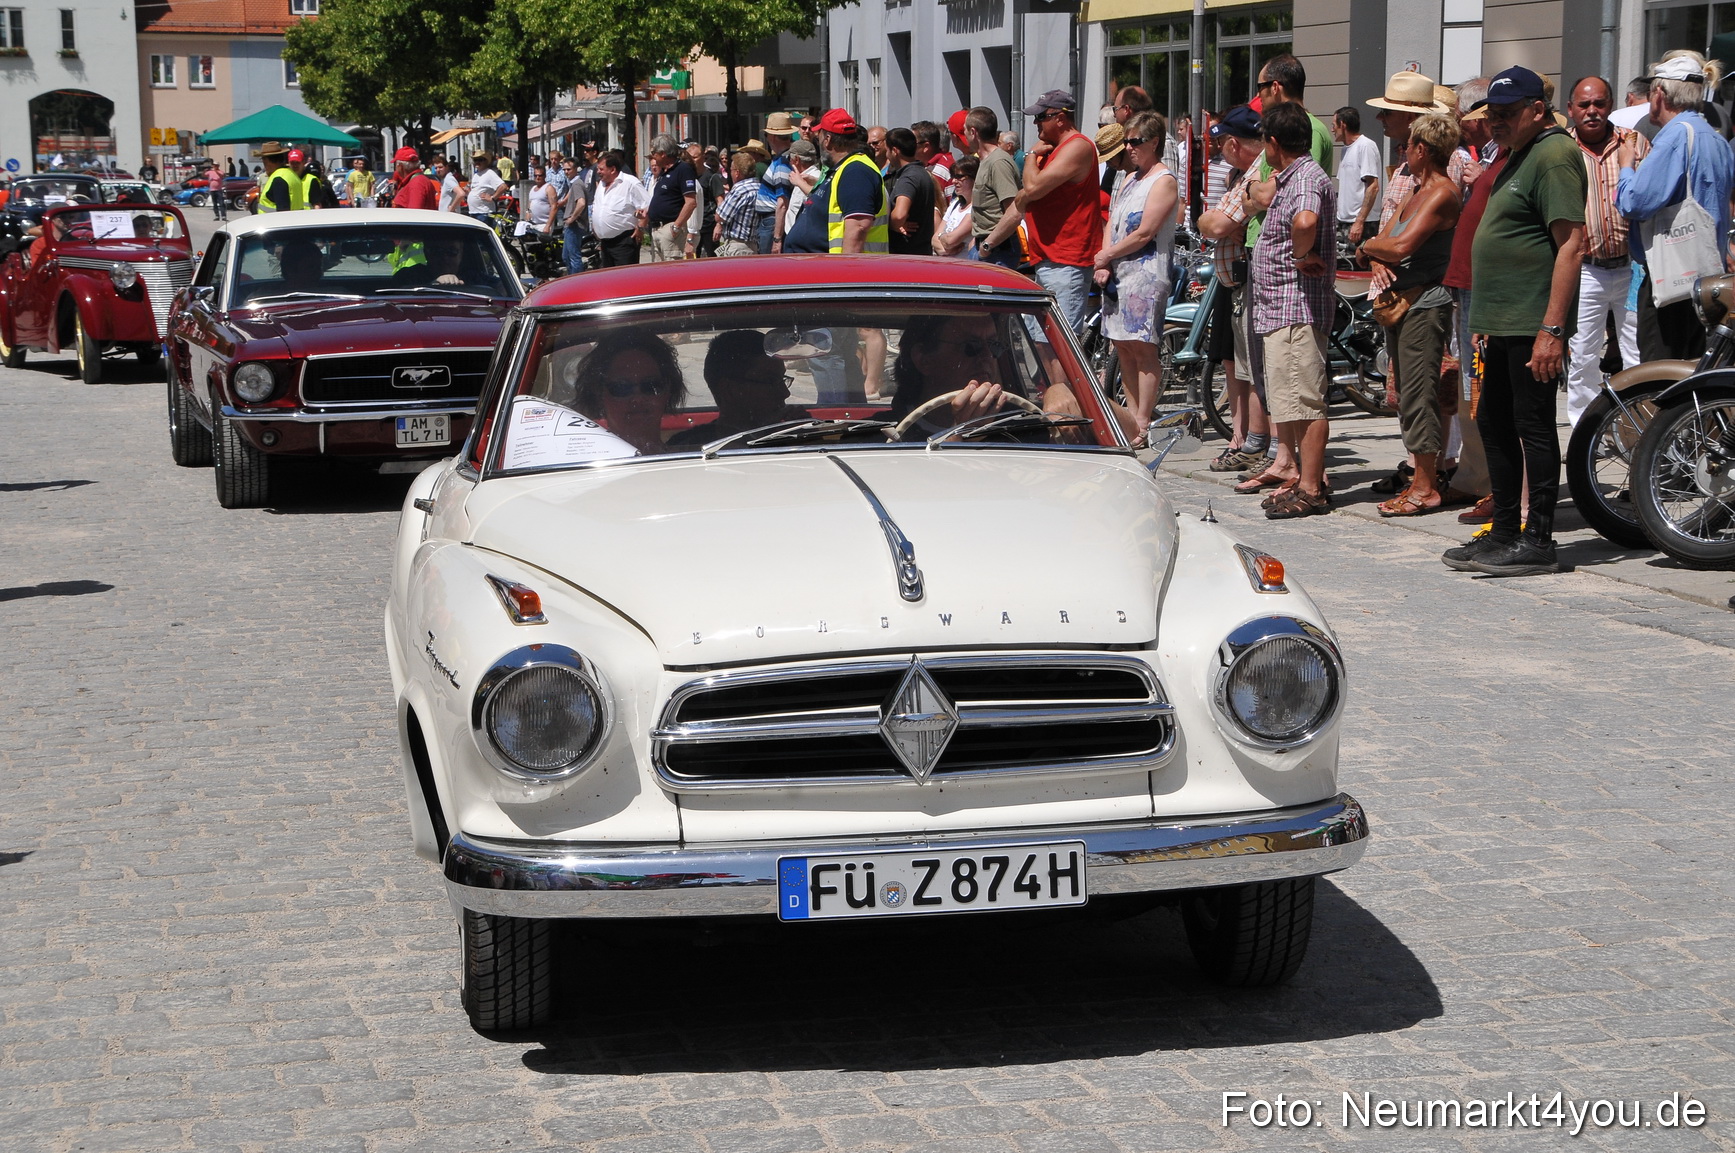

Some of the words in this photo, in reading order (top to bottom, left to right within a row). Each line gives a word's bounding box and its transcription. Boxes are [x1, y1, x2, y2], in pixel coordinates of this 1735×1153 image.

[411, 418, 428, 429] AM
[402, 430, 419, 442] TL
[423, 430, 431, 441] 7
[435, 429, 444, 440] H
[691, 609, 1128, 645] BORGWARD
[810, 861, 876, 911] FÜ
[788, 894, 800, 908] D
